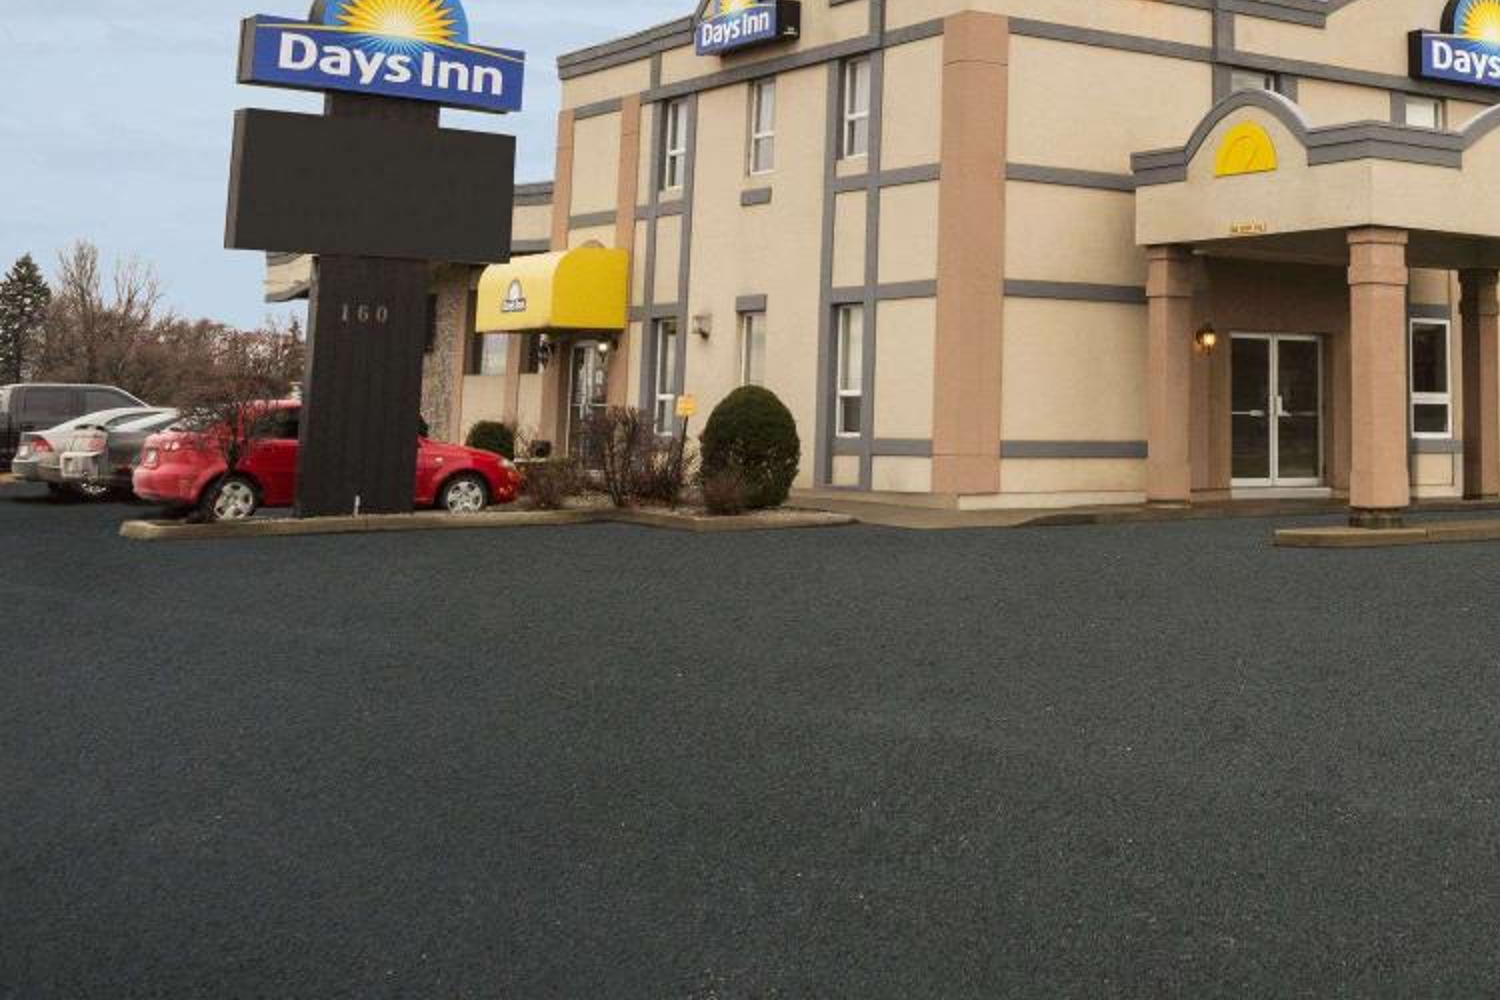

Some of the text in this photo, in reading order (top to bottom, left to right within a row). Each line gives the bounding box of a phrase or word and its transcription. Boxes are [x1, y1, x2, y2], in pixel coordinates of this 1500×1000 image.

[701, 11, 769, 47] Days Inn
[278, 31, 503, 95] Days Inn
[341, 303, 388, 323] 160
